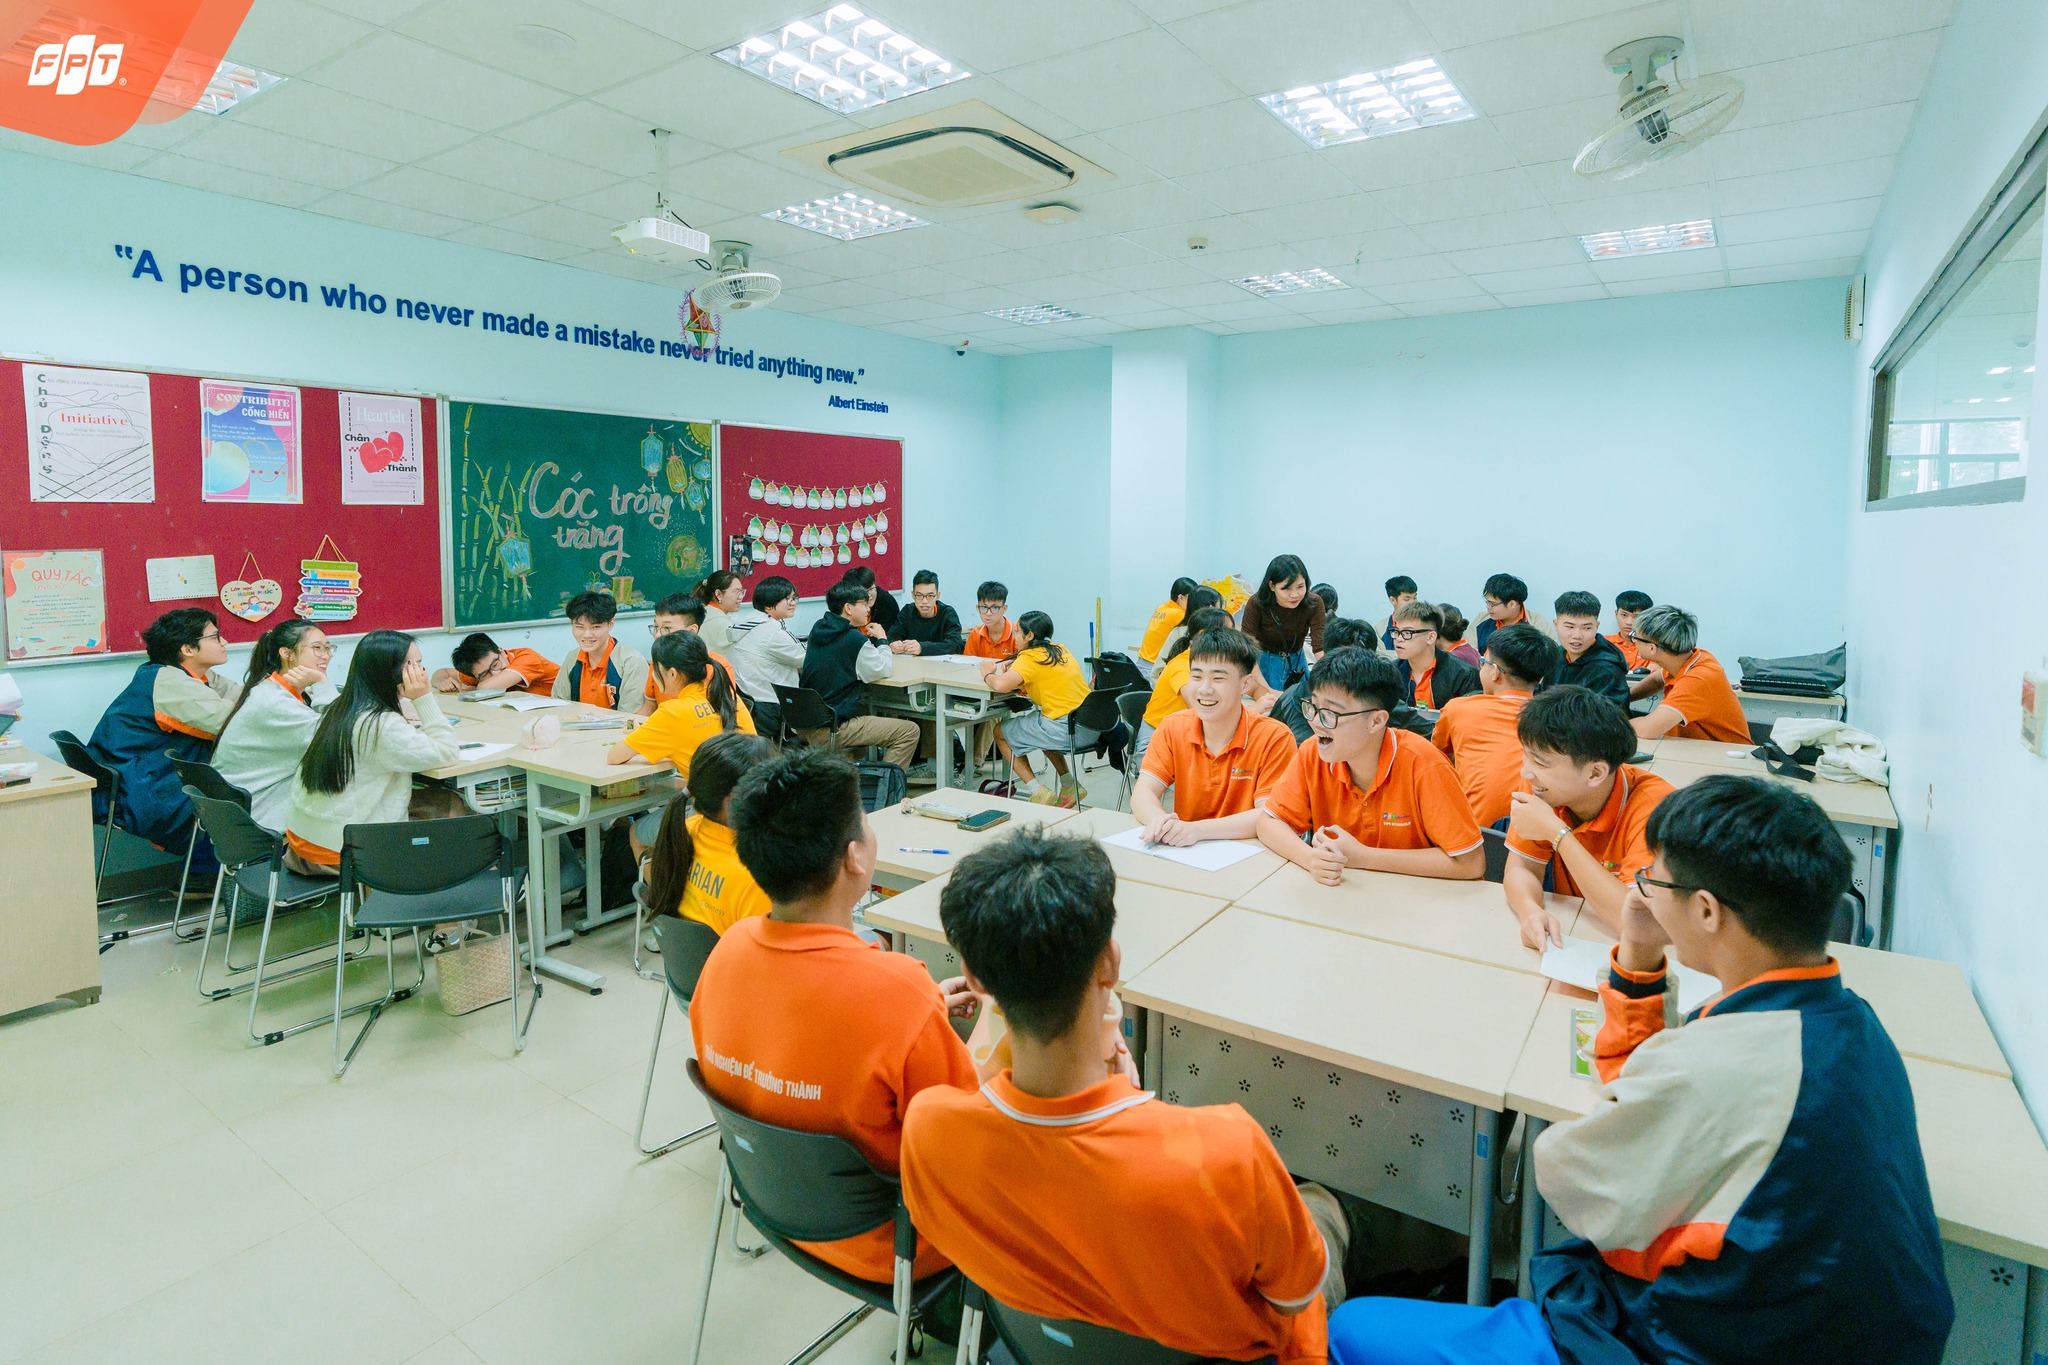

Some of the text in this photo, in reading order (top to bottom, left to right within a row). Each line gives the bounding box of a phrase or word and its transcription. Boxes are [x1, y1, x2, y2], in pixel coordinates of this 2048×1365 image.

[180, 262, 308, 303] person
[320, 284, 387, 314] who
[396, 298, 474, 327] never
[482, 308, 549, 338] made
[555, 324, 569, 342] a
[574, 325, 655, 354] mistake
[660, 339, 711, 363] never
[715, 345, 753, 369] tried
[758, 354, 822, 384] anything
[216, 393, 290, 408] CONTRIBUTE
[828, 394, 888, 414] Albert Einstein
[60, 412, 128, 426] Initiative
[355, 406, 406, 424] Heartfelt
[344, 433, 370, 442] Chân
[387, 463, 417, 473] Thành
[528, 461, 598, 519] Cóc
[31, 568, 62, 582] QUY
[786, 1080, 822, 1101] THÀNH
